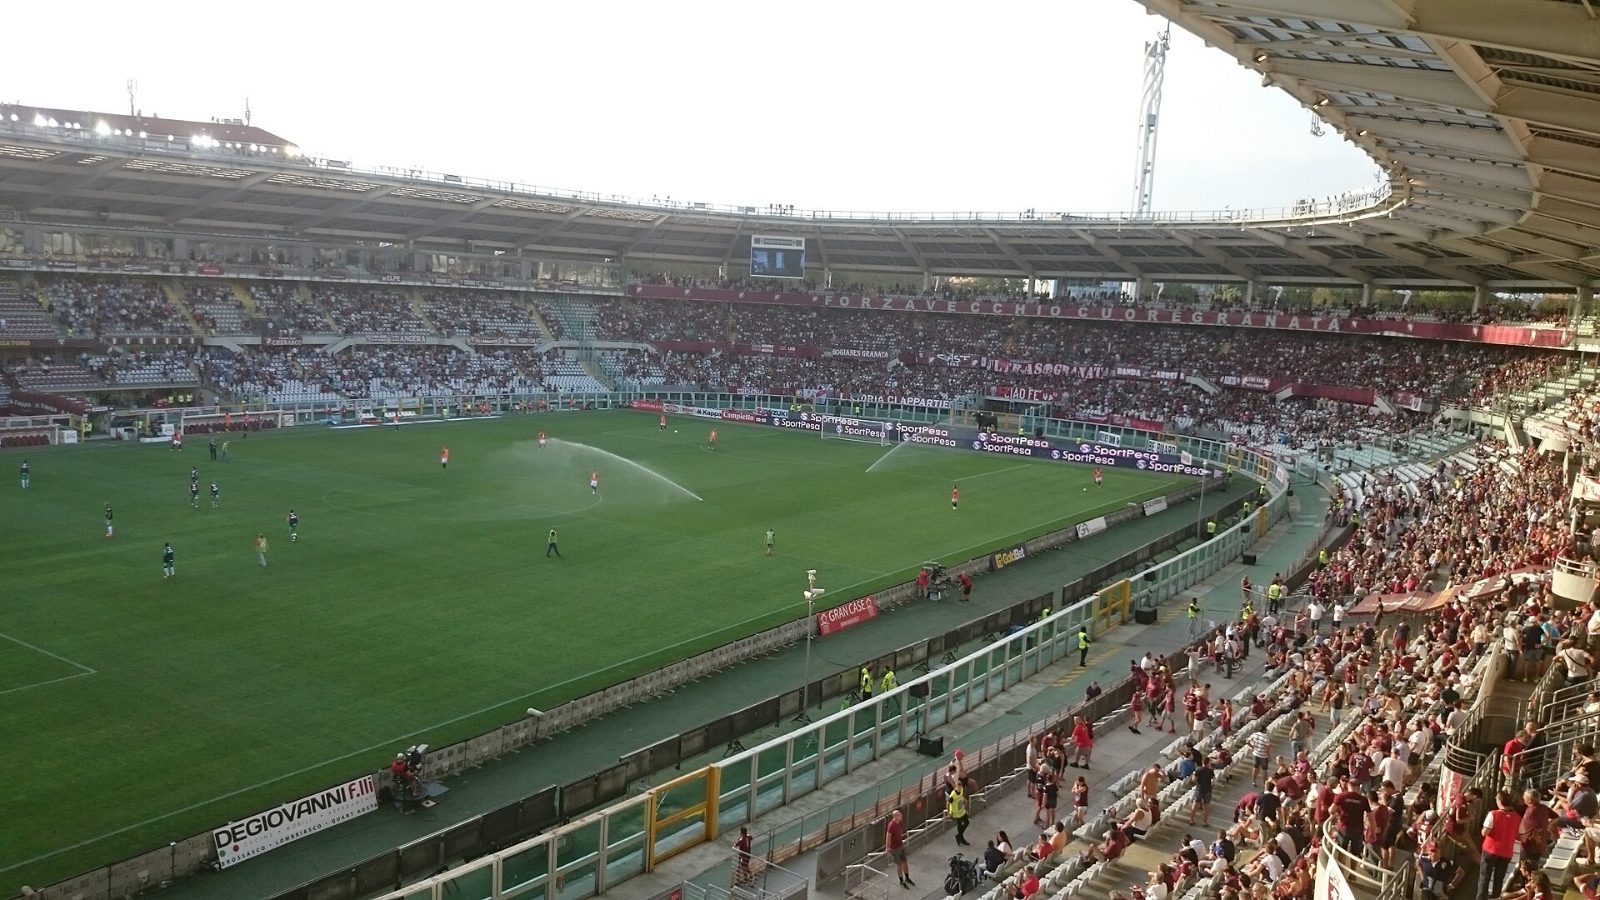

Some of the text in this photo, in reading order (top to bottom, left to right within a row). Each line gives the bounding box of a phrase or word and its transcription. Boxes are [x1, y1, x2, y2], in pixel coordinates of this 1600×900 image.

[861, 350, 889, 358] GRANATA
[703, 409, 722, 417] Kappa
[811, 412, 859, 427] SportPesa
[781, 418, 820, 431] SportPesa
[845, 425, 886, 439] SportPesa
[895, 422, 948, 437] SportPesa
[911, 432, 956, 447] SportPesa
[990, 433, 1049, 448] SportPesa
[982, 441, 1032, 456] SportPesa
[1093, 444, 1159, 463] SportPesa
[1062, 450, 1115, 466] SportPesa
[1148, 459, 1206, 476] SportPesa
[1002, 546, 1025, 565] GoldBet
[828, 605, 849, 622] GRAN
[848, 600, 866, 615] CASE
[215, 776, 374, 849] DEGIOVANNI F.lli
[221, 802, 379, 867] BROSSASCO LOMBRIASCO QUART AOSTA
